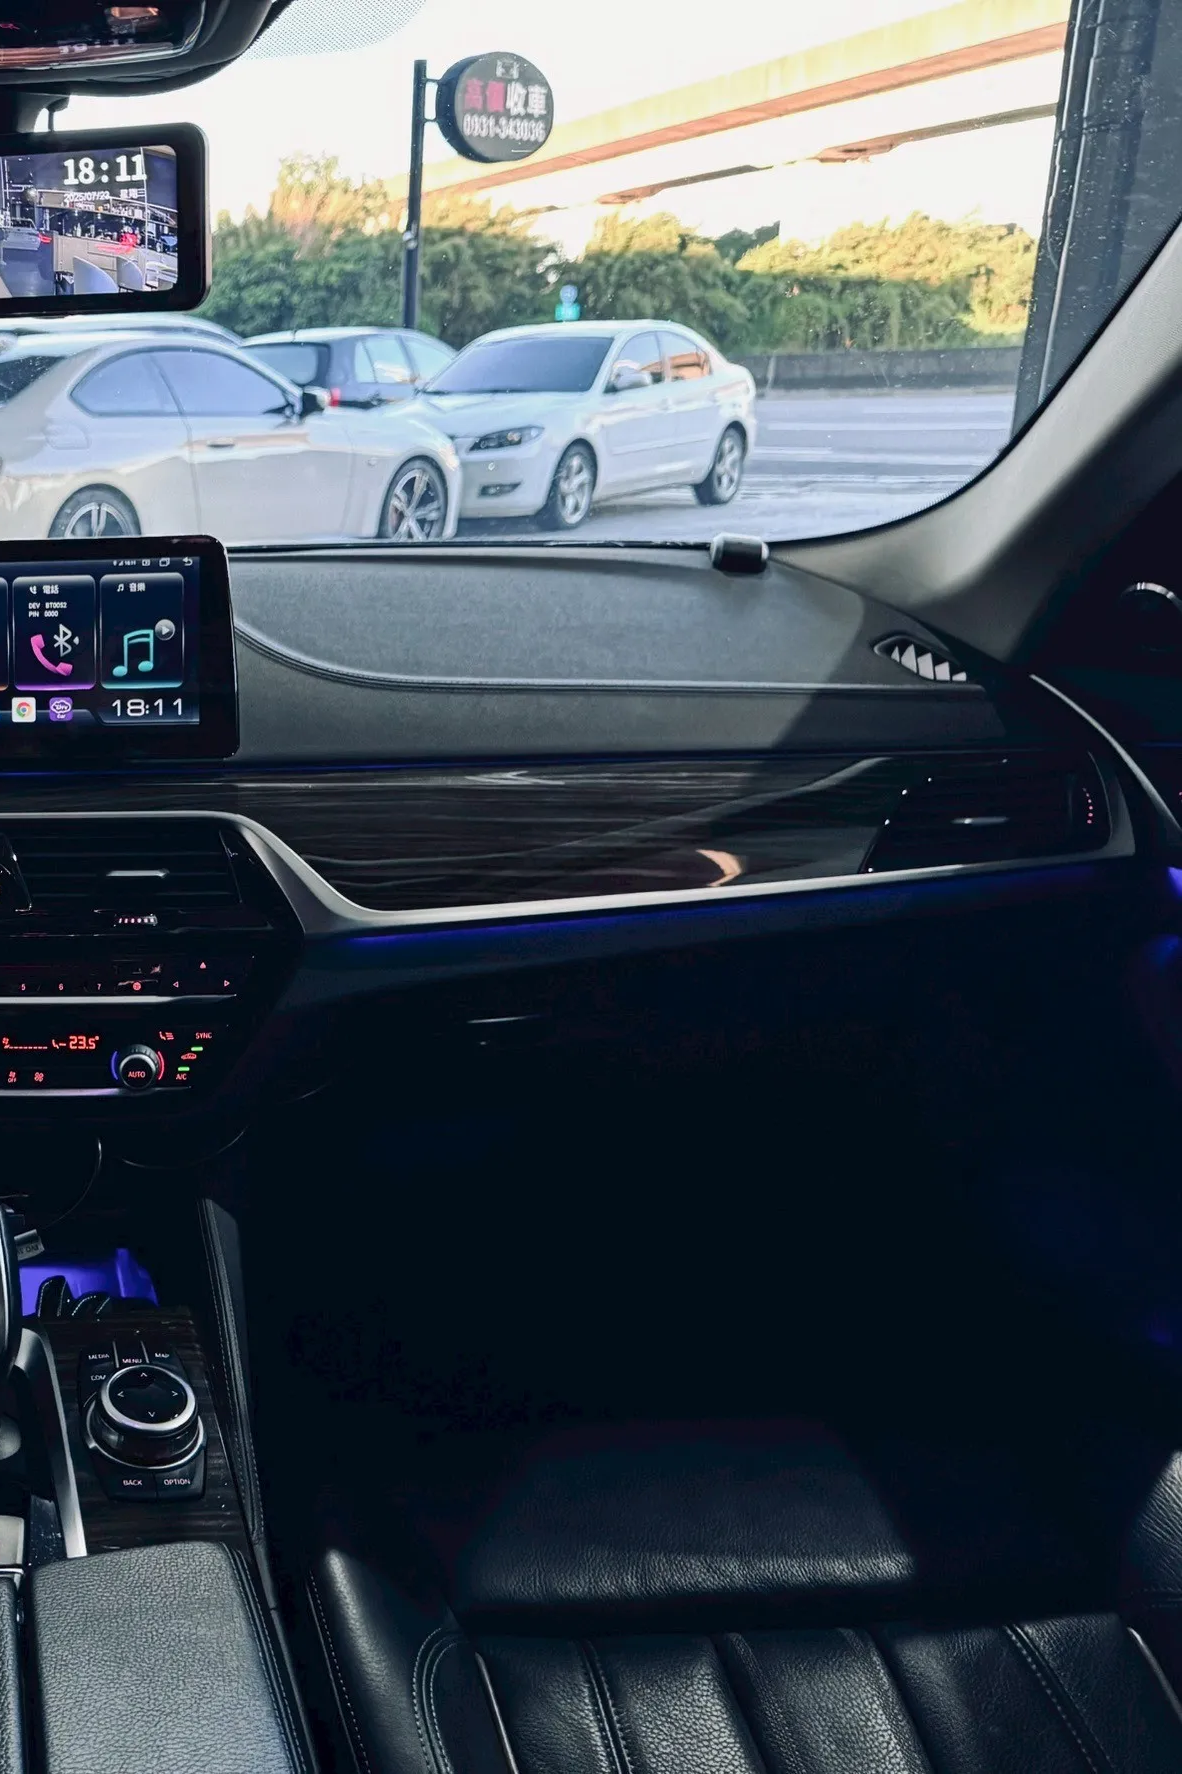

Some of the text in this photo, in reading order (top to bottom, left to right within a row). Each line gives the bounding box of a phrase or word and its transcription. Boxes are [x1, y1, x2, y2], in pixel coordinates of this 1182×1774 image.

[63, 154, 147, 185] 18:11
[42, 584, 59, 595] 電話
[44, 610, 59, 618] 0000
[112, 697, 183, 717] 18:11
[195, 1032, 213, 1040] SYNC
